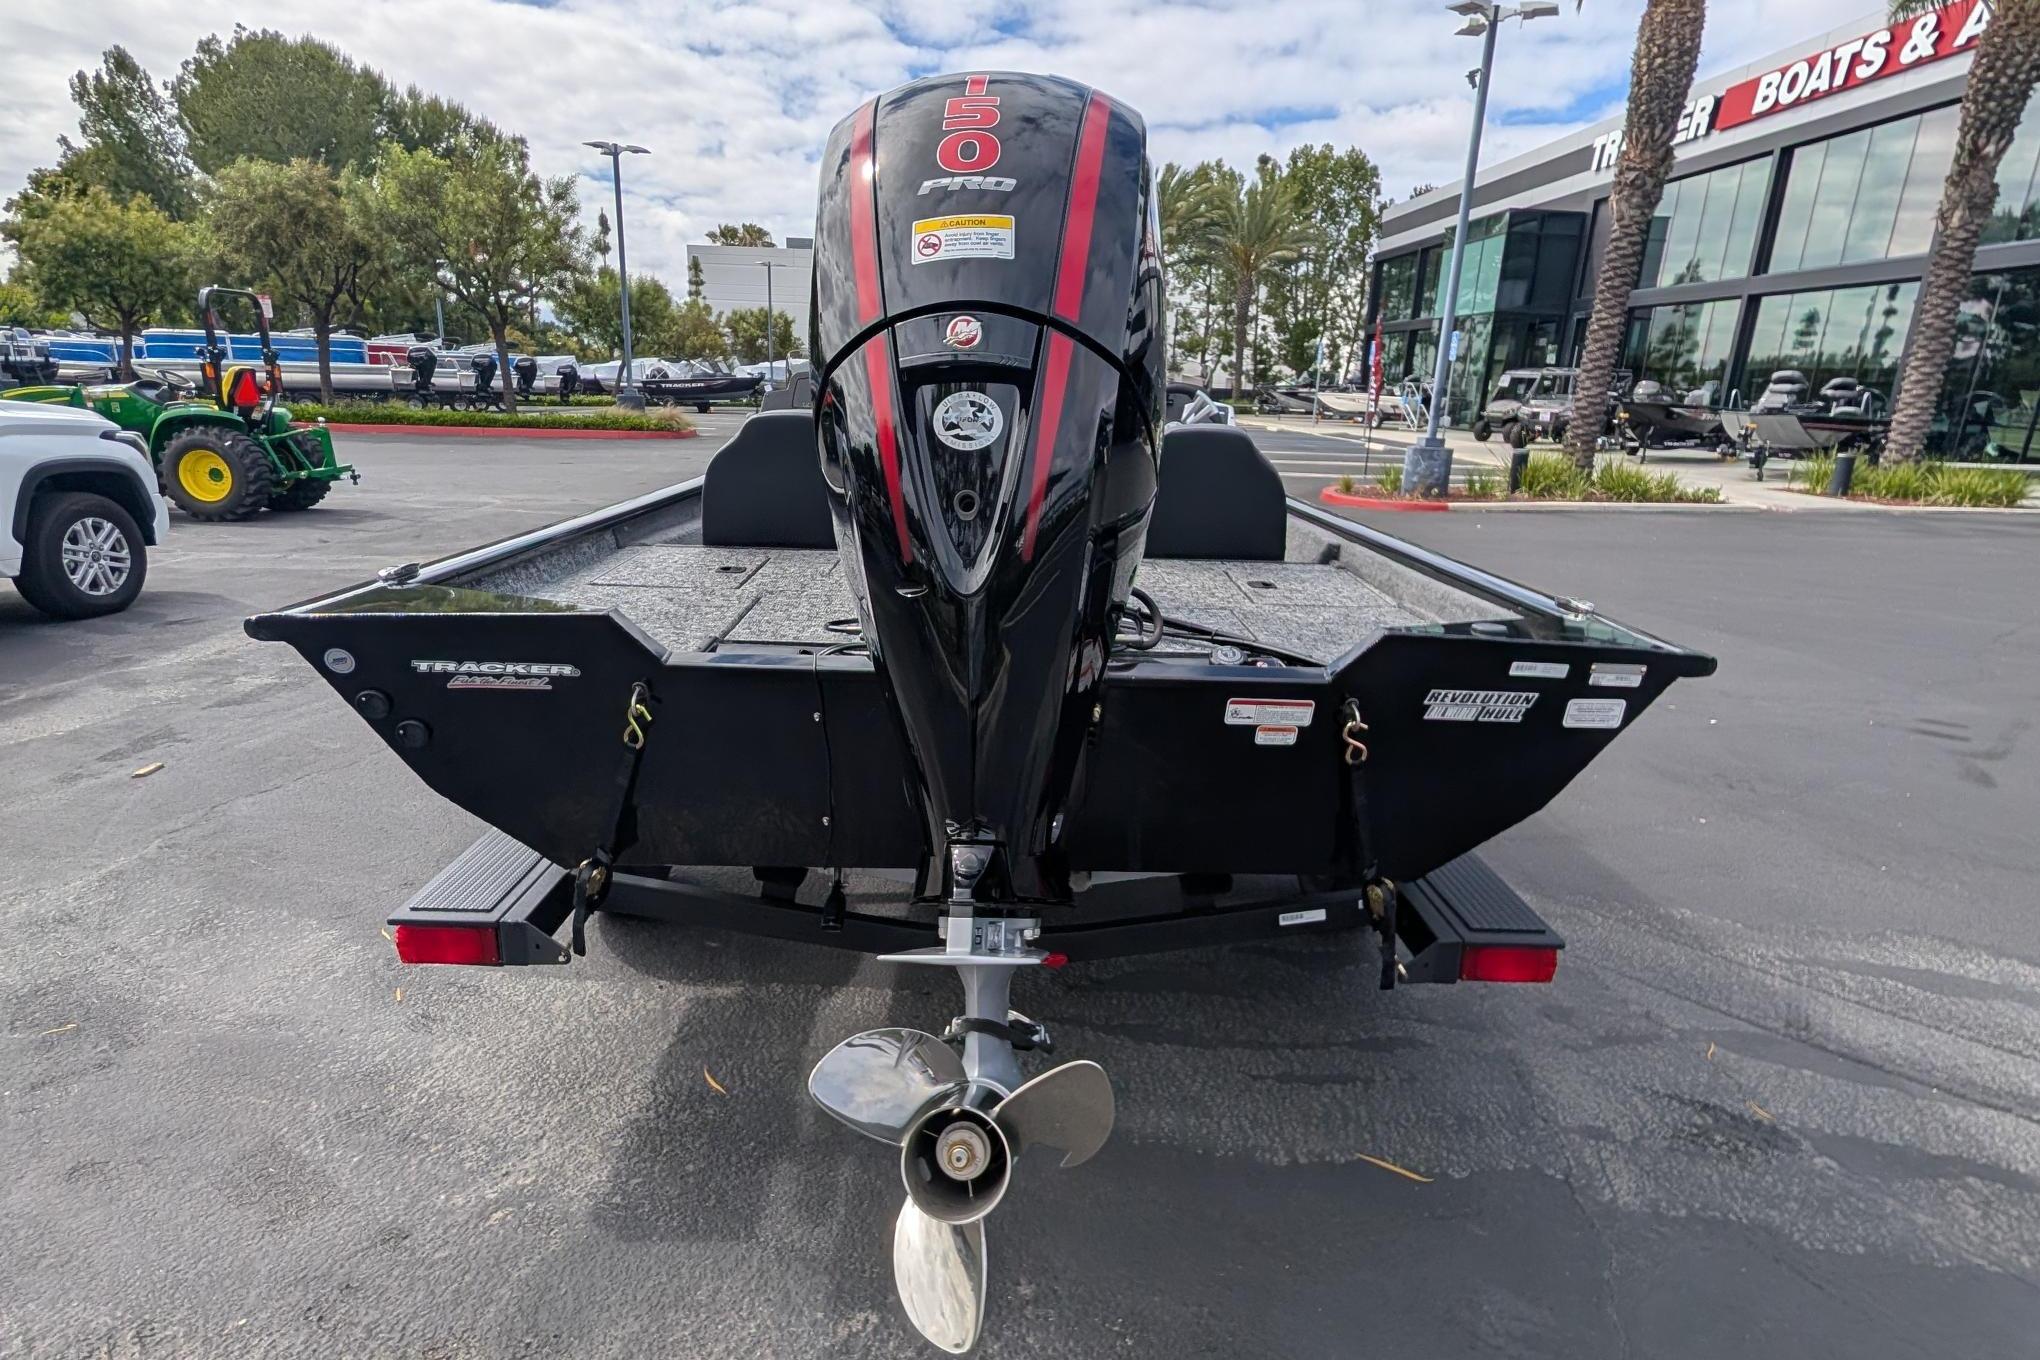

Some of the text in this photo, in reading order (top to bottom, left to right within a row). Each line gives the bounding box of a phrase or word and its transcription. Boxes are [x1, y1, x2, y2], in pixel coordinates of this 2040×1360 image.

[1591, 95, 1715, 171] TRER
[1752, 29, 1891, 115] BOATS
[1899, 12, 1940, 65] &
[937, 75, 1000, 173] 150
[917, 176, 1017, 195] PRO
[949, 219, 986, 227] CAUTION
[978, 395, 998, 410] LOW
[412, 660, 573, 676] TRACKER
[1426, 690, 1538, 707] REVOLUTION
[1480, 706, 1523, 721] HULL
